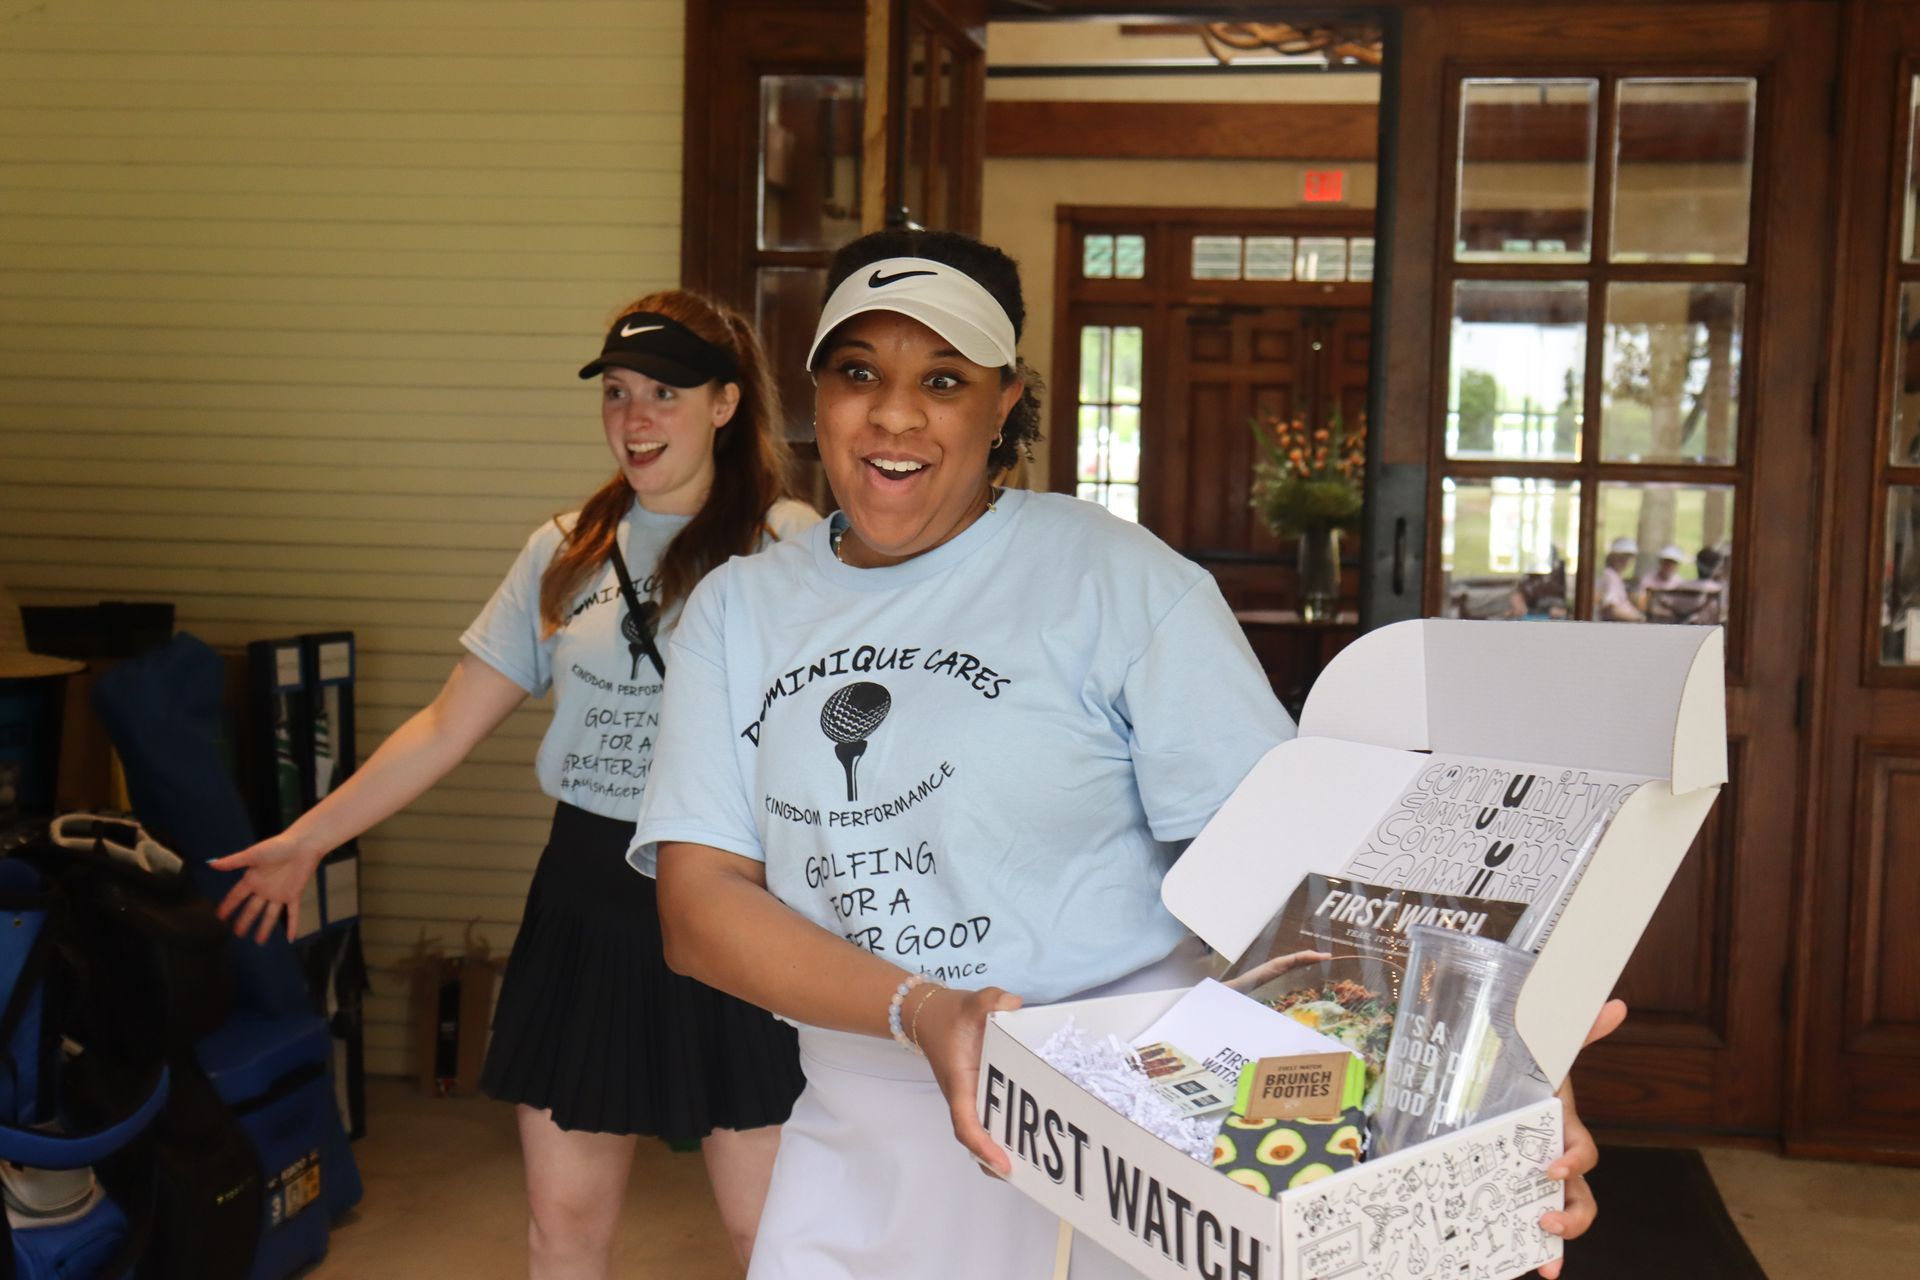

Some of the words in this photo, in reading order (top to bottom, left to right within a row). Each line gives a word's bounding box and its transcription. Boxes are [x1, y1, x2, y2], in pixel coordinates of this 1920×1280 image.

[741, 645, 921, 748] DOMINIQUE
[923, 649, 1012, 699] CARES
[600, 734, 633, 751] FOR
[638, 736, 652, 754] A
[765, 794, 822, 827] KINGDOM
[805, 841, 937, 889] GOLFING
[829, 888, 878, 924] FOR
[888, 888, 911, 916] A
[1315, 889, 1400, 929] FIRST
[1397, 903, 1488, 939] WATCH
[896, 916, 992, 956] GOOD
[1429, 1020, 1447, 1045] A
[1262, 1084, 1330, 1099] FOOTIES
[1265, 1071, 1332, 1086] BRUNCH
[1420, 1070, 1438, 1095] A
[982, 1063, 1092, 1200] FIRST
[1101, 1144, 1263, 1280] WATCH
